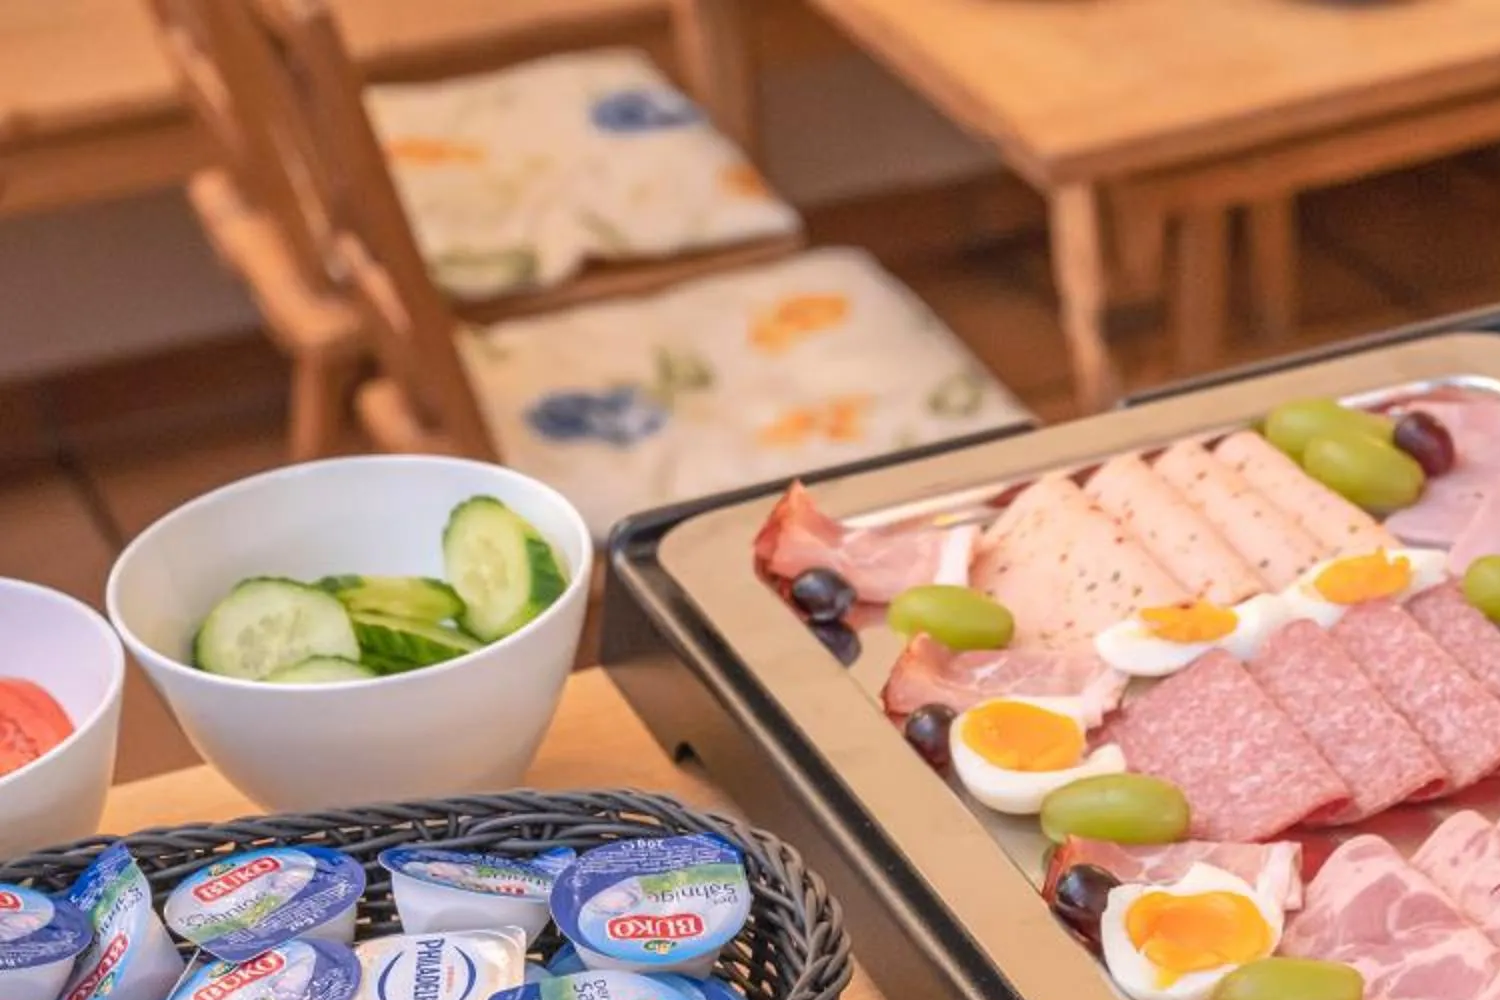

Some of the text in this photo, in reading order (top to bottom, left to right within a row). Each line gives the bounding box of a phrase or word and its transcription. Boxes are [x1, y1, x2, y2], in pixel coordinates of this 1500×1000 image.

[199, 857, 278, 900] BUKO
[614, 914, 698, 938] BUKO
[594, 979, 607, 1000] Der
